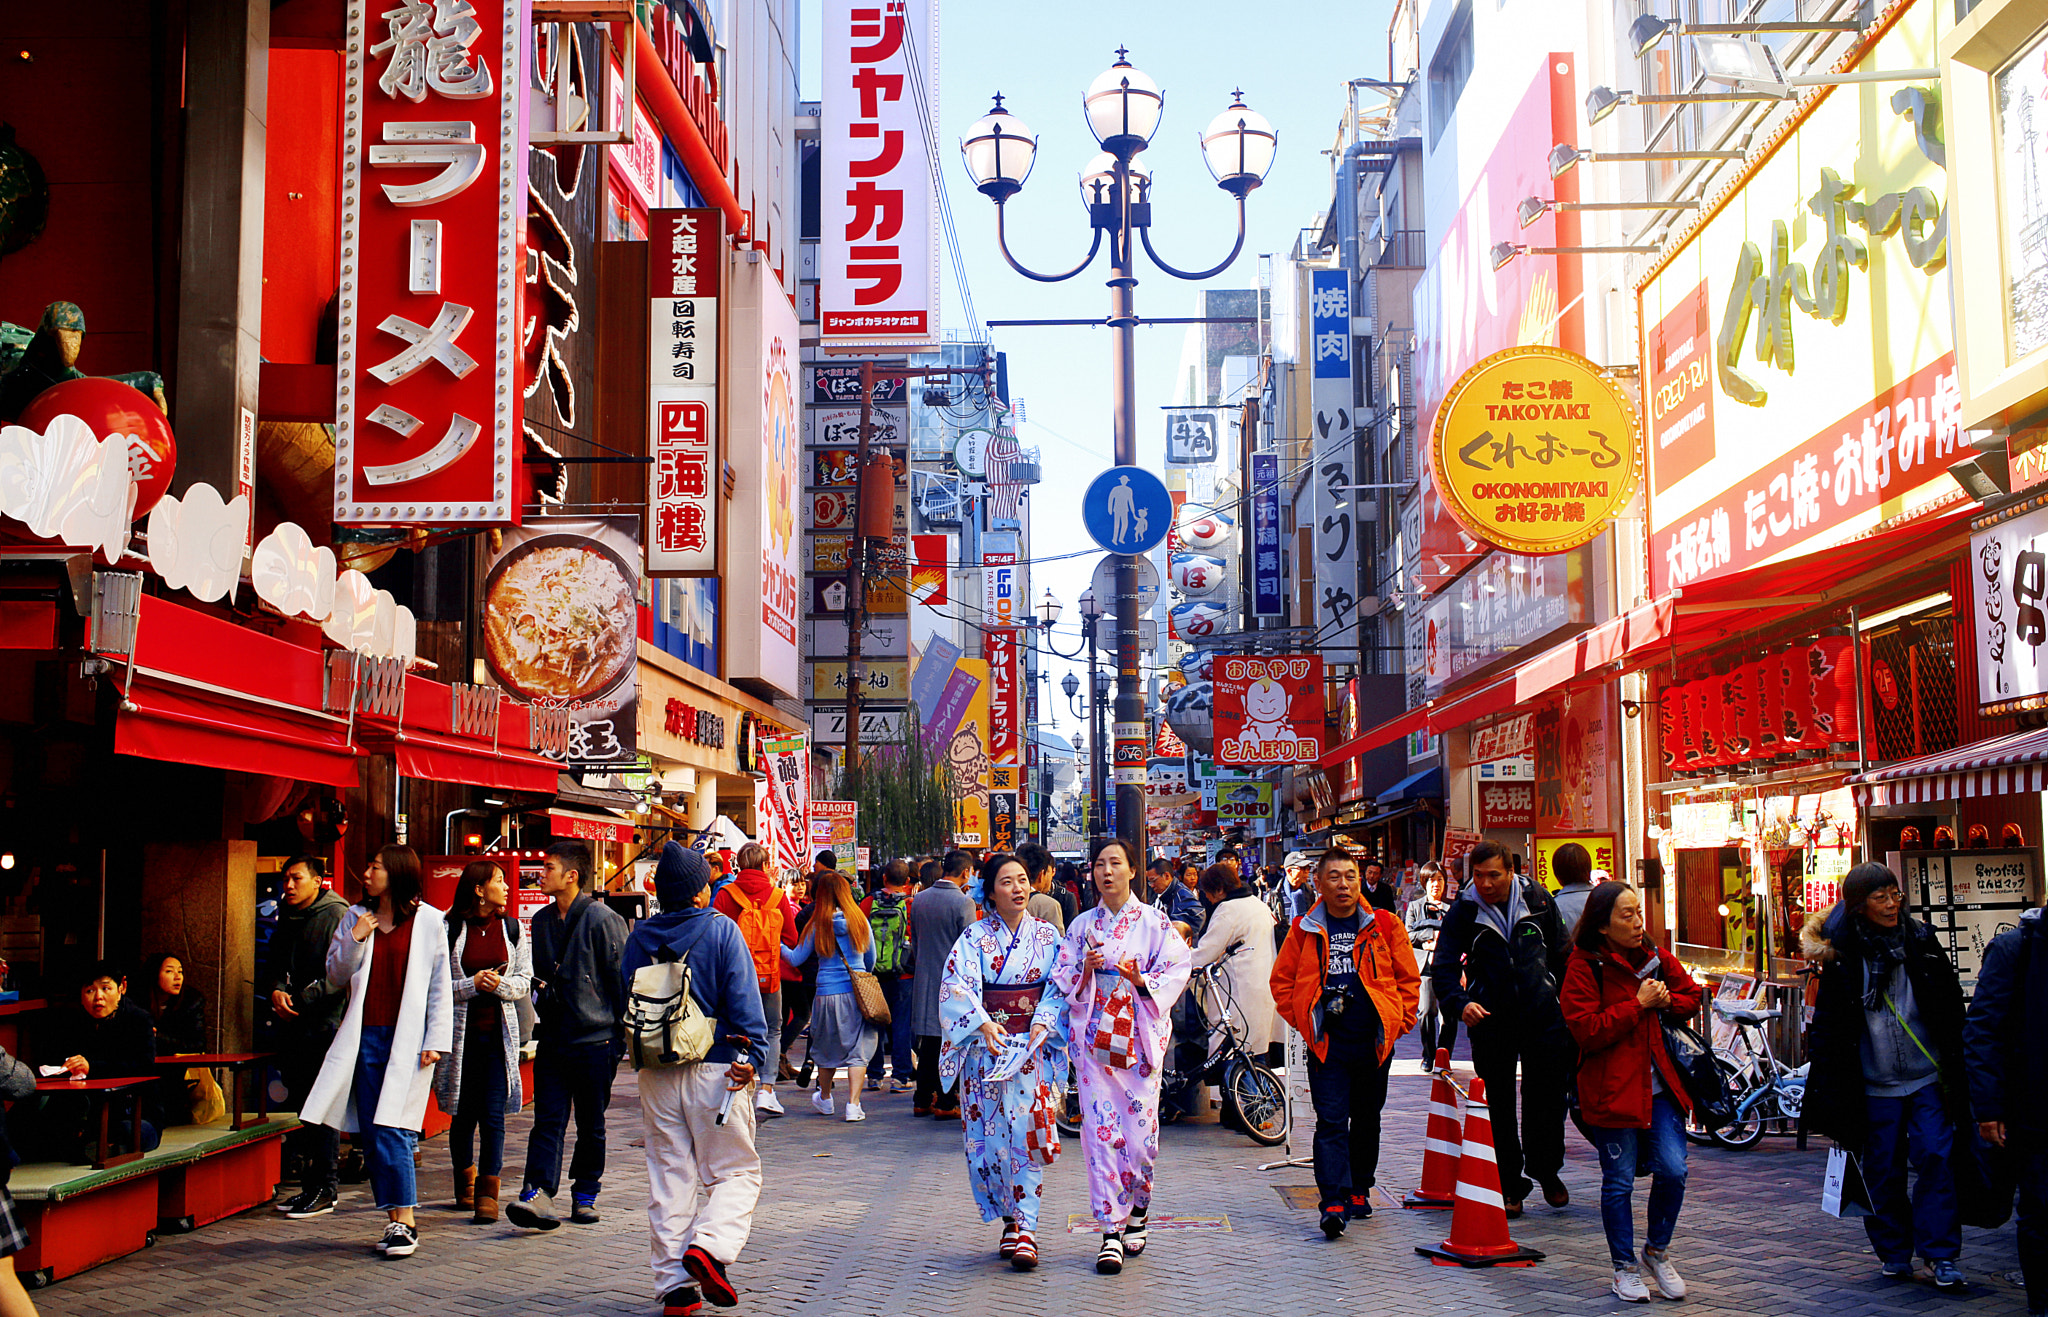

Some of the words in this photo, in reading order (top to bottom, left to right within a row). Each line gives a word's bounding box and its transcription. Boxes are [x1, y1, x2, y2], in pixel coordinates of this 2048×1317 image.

[845, 2, 904, 306] ジャンカラ
[361, 0, 494, 486] 龍ラーメン
[671, 214, 698, 295] 大起水産
[1313, 287, 1349, 361] 焼肉
[671, 300, 697, 380] 回転寿司
[1502, 379, 1573, 401] たこ焼
[1485, 403, 1590, 421] TAKOYAKI
[1172, 422, 1212, 453] 牛角
[126, 433, 162, 482] 金
[1459, 430, 1622, 471] くれおーる
[656, 400, 706, 553] 四海樓
[1256, 469, 1275, 480] 元祖
[1472, 481, 1608, 499] OKONOMIYAKI
[1316, 407, 1353, 628] いろりや
[1495, 502, 1586, 523] お好み焼
[1666, 506, 1731, 590] 大阪名物
[762, 548, 797, 621] ジャンカラ
[1226, 659, 1311, 680] おみやげ
[1874, 667, 1893, 693] 2F
[830, 716, 892, 733] ZZA
[1286, 718, 1322, 726] Souvenir
[1221, 738, 1319, 762] とんぼり屋
[1145, 782, 1188, 796] づぼら
[1484, 787, 1532, 811] 免税
[811, 803, 853, 813] KARAOKE
[1486, 814, 1530, 824] Tax-Free
[1805, 854, 1818, 875] 2F
[1975, 862, 2026, 879] 串かつだるま
[1976, 878, 2026, 890] なんばマップ
